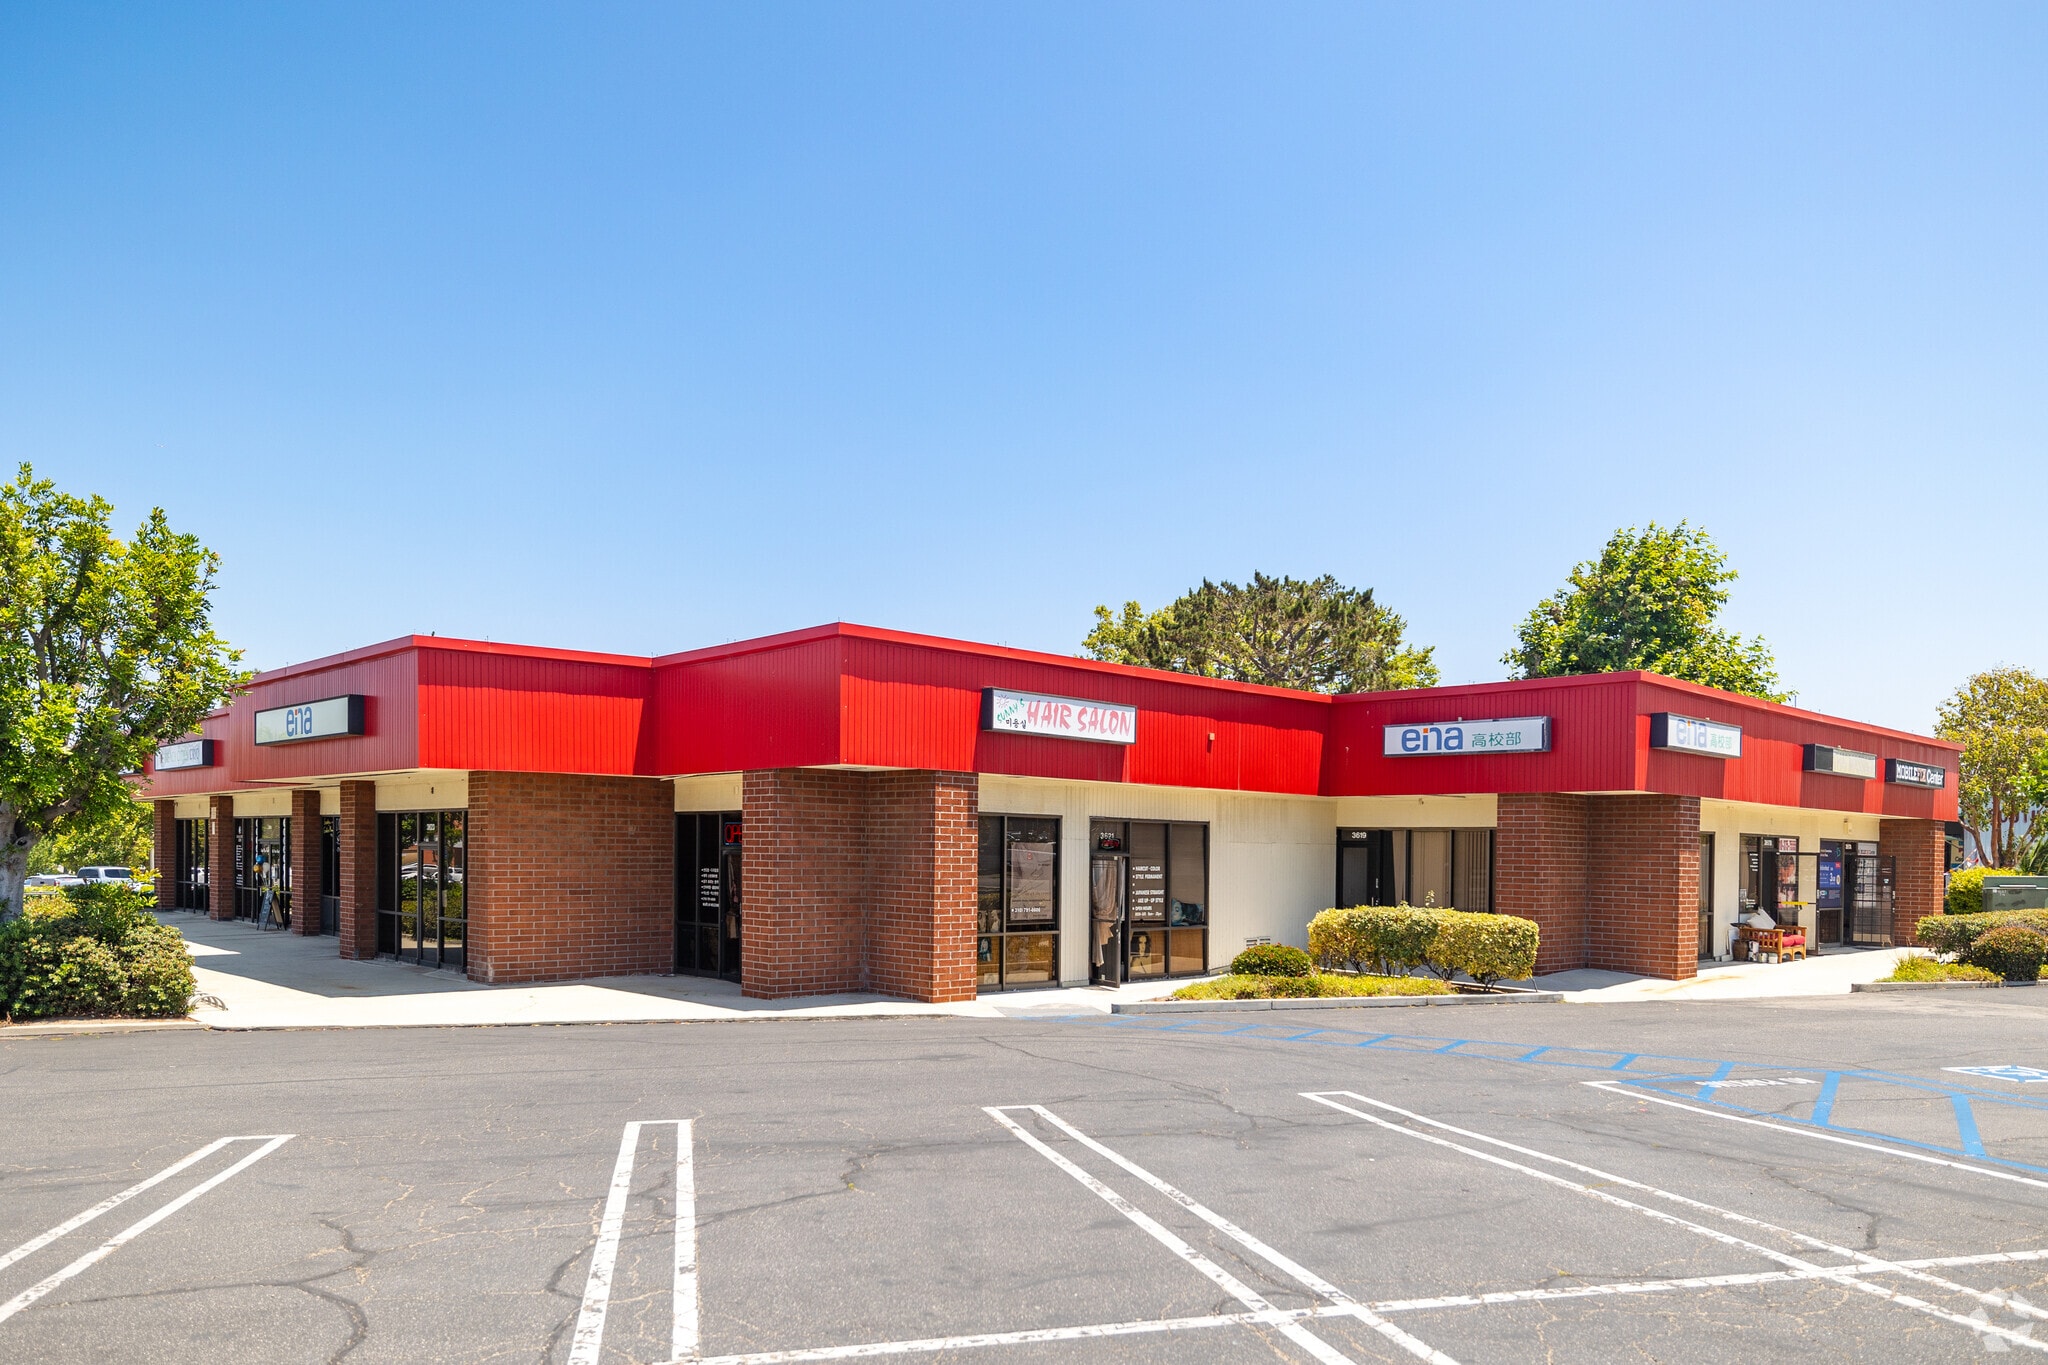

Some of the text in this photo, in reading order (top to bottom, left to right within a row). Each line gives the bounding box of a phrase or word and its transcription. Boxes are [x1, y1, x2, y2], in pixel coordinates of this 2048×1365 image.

[286, 706, 312, 737] ena
[997, 698, 1025, 723] SUNNY'S
[1027, 700, 1132, 736] HAIR SALON
[1401, 727, 1463, 752] ena
[1472, 731, 1521, 747] 高校部
[1677, 719, 1707, 748] ena
[1927, 769, 1943, 785] Center
